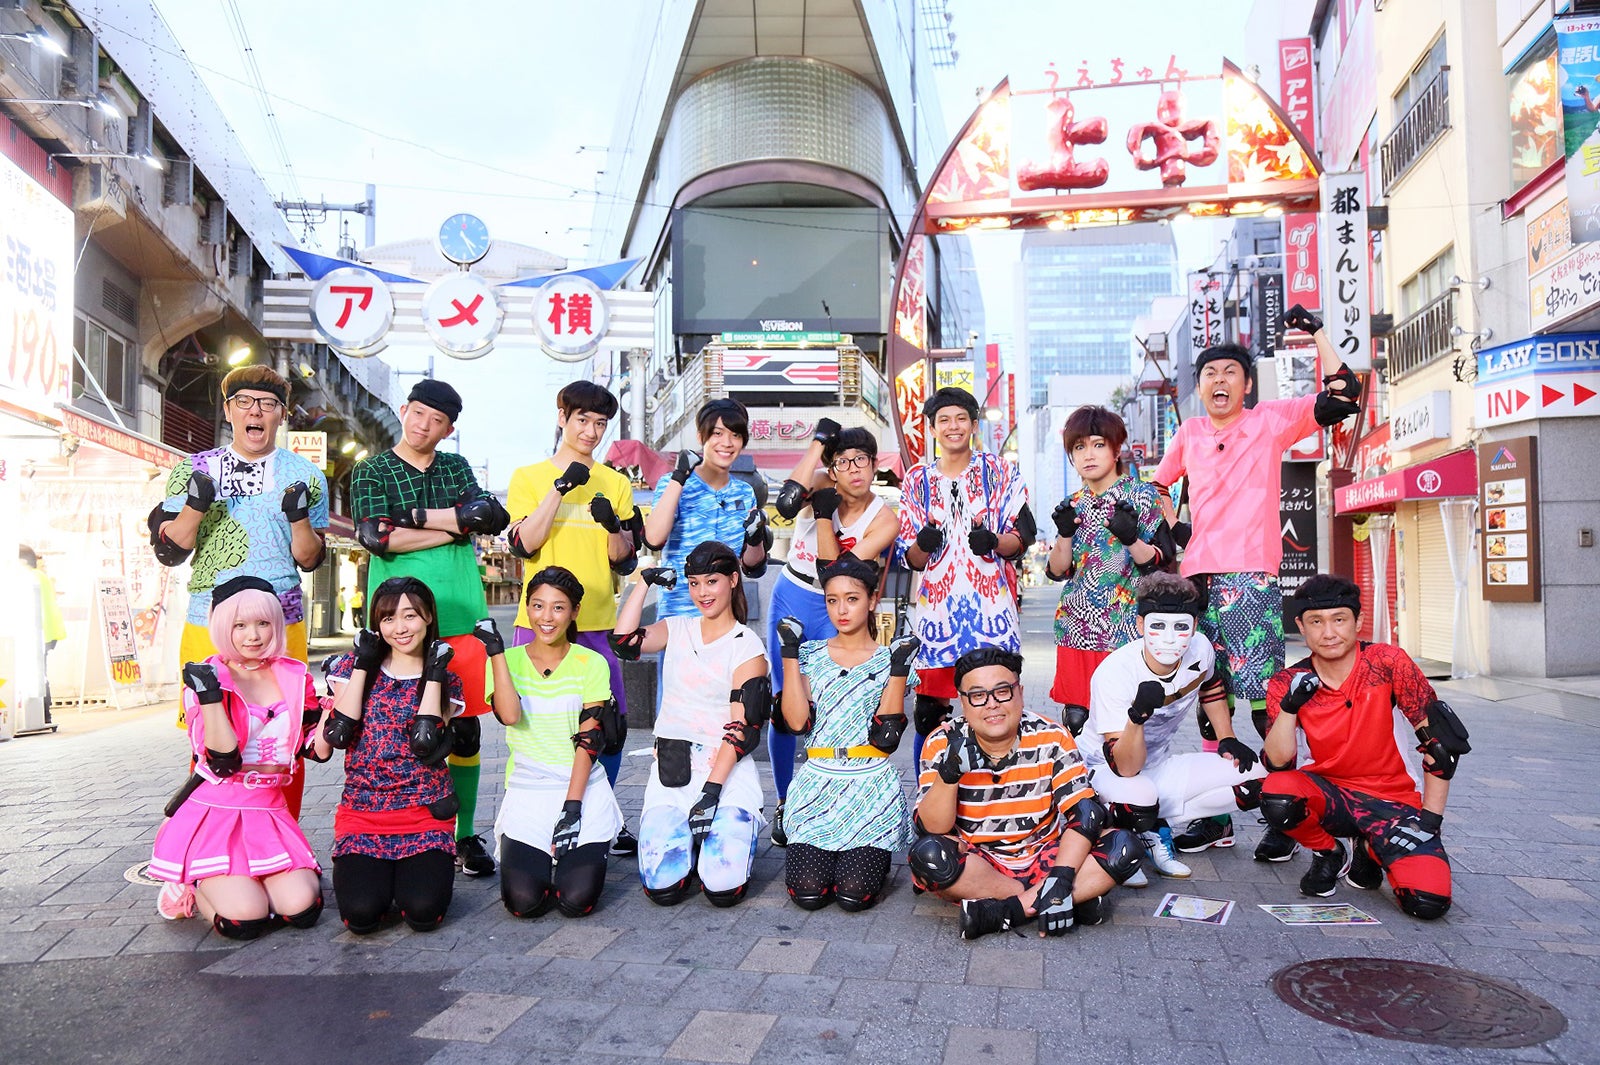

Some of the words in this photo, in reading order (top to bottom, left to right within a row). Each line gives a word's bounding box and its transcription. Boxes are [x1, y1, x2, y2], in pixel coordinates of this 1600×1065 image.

[1043, 54, 1188, 87] うえちゅん
[1017, 90, 1222, 192] 上中
[1289, 222, 1316, 292] ゲーム
[1331, 186, 1360, 355] 都まんじゅう
[329, 285, 593, 335] アメ横
[1265, 289, 1275, 348] ROOMPIA
[8, 308, 70, 399] 190円
[1485, 340, 1600, 375] LAWSON
[1487, 389, 1512, 419] IN
[292, 436, 322, 446] ATM
[750, 419, 814, 440] 横セン
[112, 661, 142, 681] 190円
